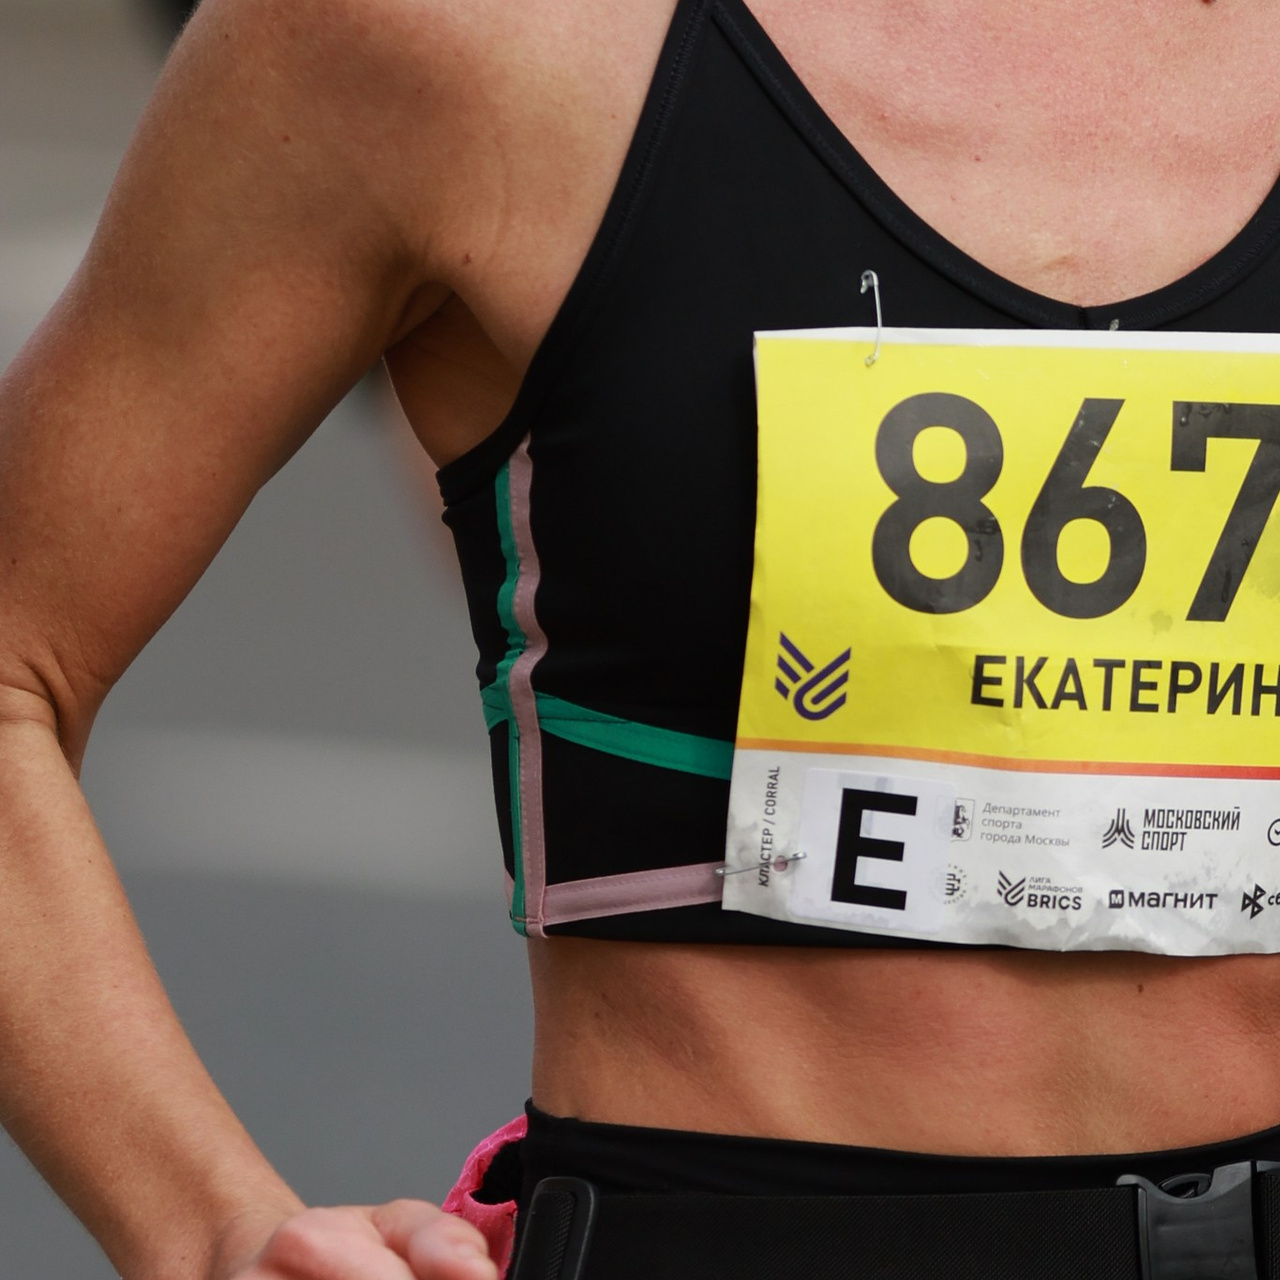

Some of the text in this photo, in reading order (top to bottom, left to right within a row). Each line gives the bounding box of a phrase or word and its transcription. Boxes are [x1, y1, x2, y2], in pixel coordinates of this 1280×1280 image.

[764, 765, 780, 816] CORRAL
[982, 802, 1061, 818] Департамент
[1143, 806, 1241, 831] МОСКОВСКИЙ
[981, 817, 1023, 830] спорта
[980, 831, 1070, 847] города Москвы
[1141, 830, 1188, 852] СПОРТ
[758, 827, 774, 888] КЛАСТЕР
[829, 787, 918, 912] E
[1028, 883, 1083, 894] МАРАФОНОВ
[1029, 876, 1051, 884] ЛИГА
[1027, 893, 1082, 910] BRICS
[1128, 891, 1219, 909] магнит
